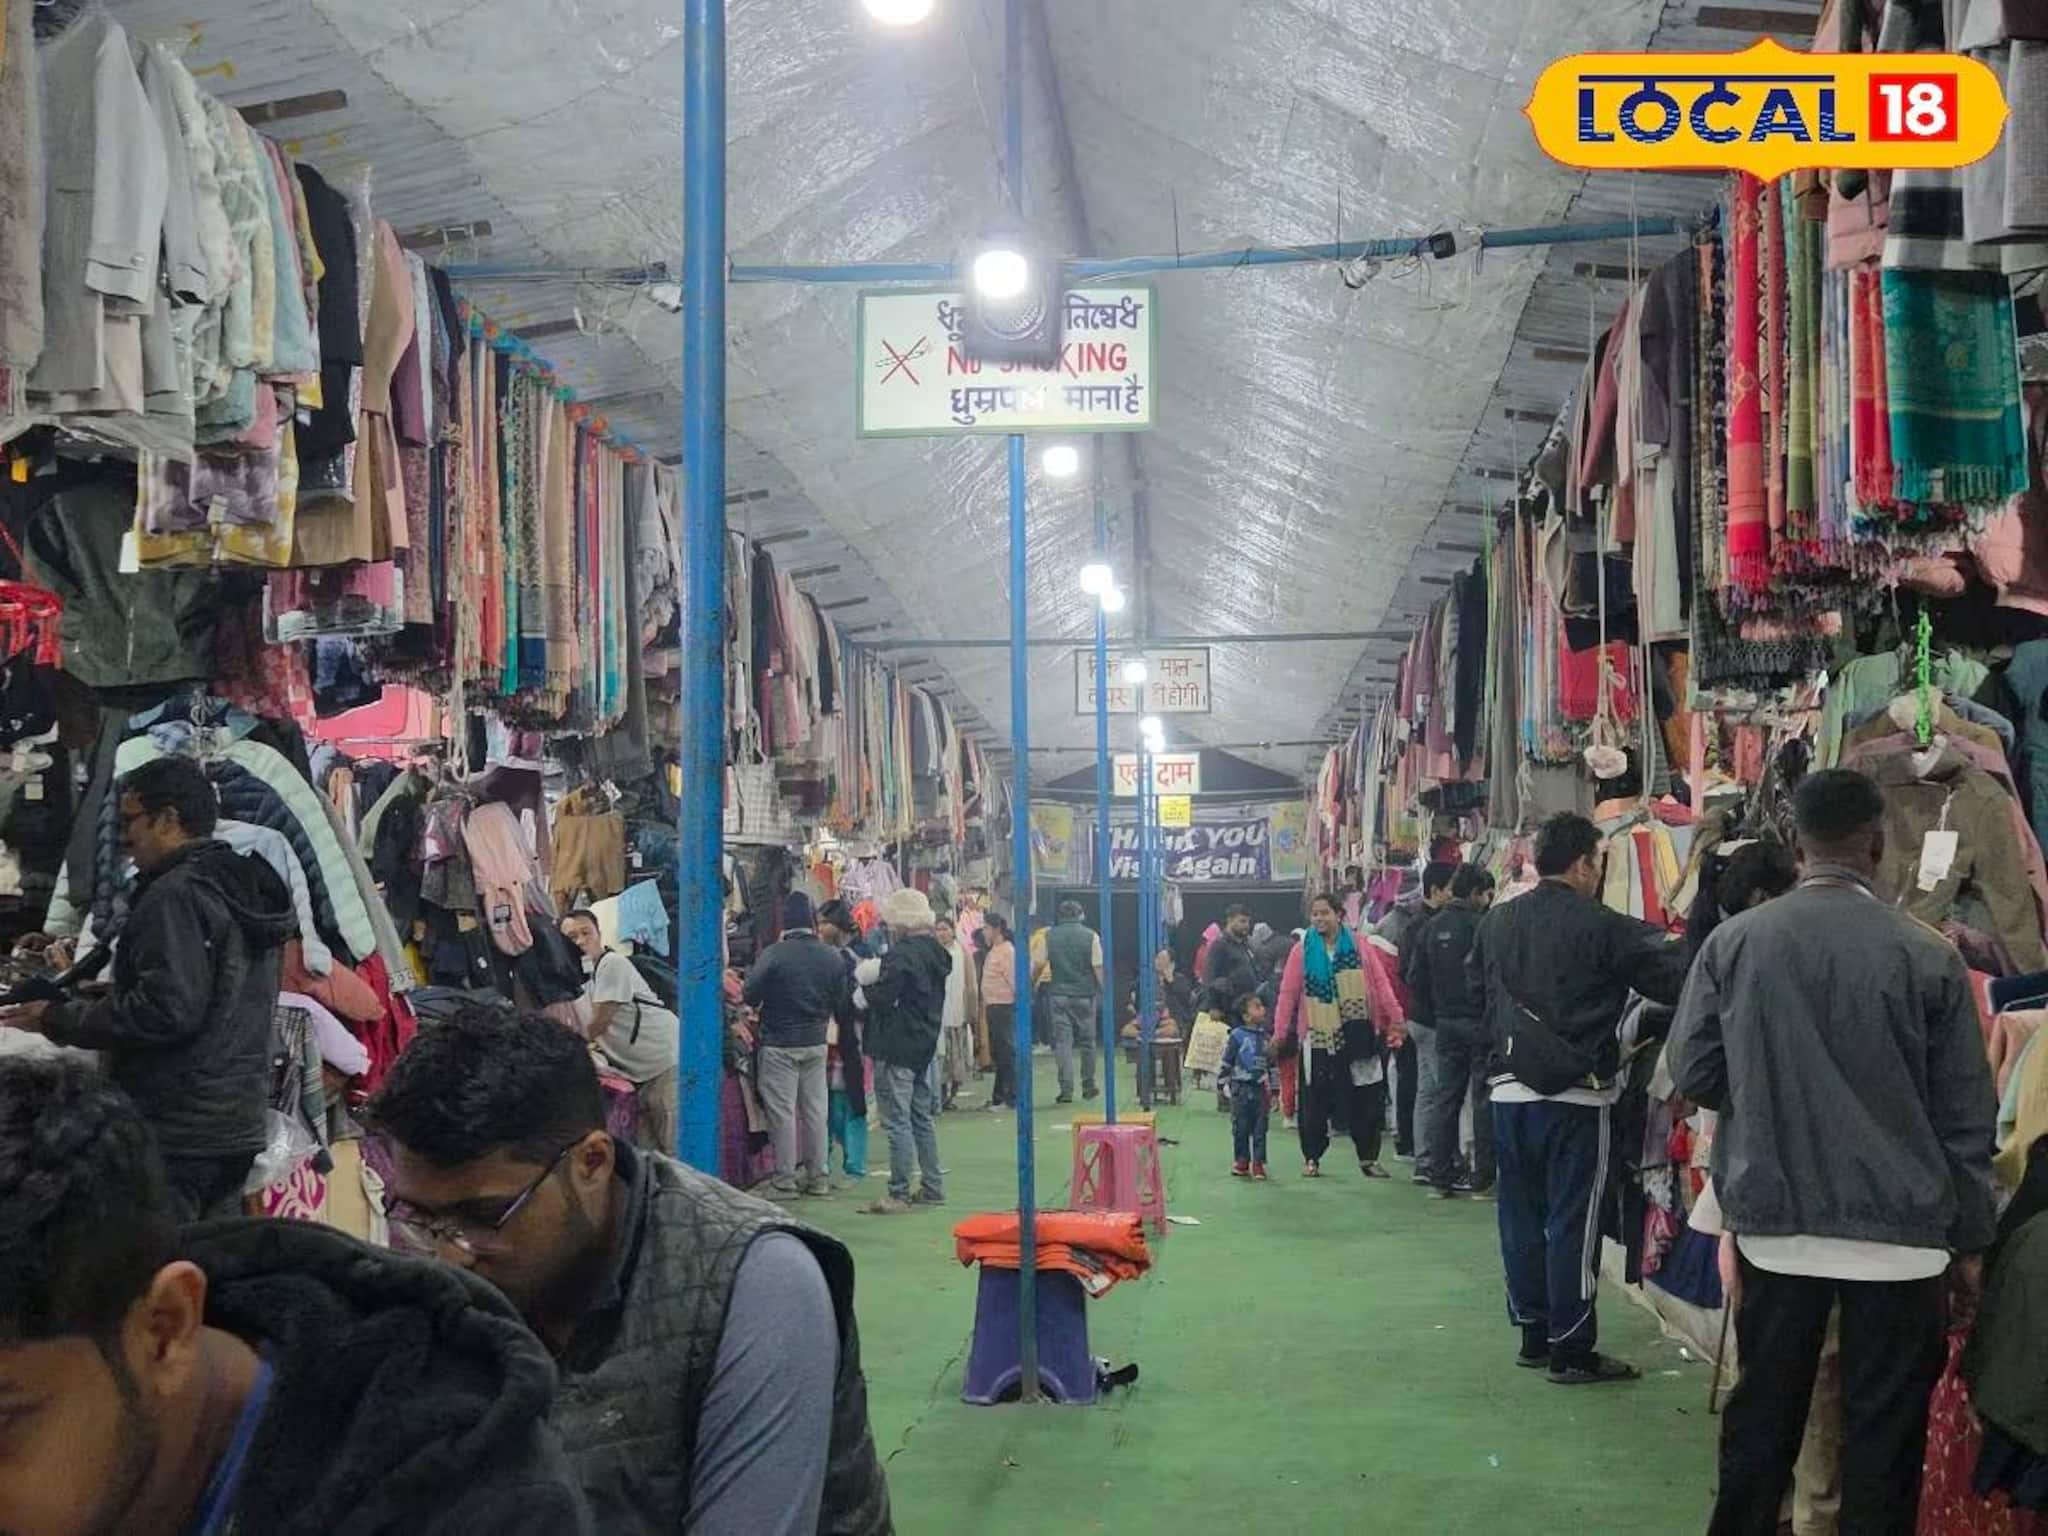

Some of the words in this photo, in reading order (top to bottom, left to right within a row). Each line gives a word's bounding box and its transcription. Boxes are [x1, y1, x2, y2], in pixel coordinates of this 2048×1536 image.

[1156, 762, 1195, 787] दाम
[1205, 822, 1267, 849] YOU
[1175, 852, 1257, 881] Again
